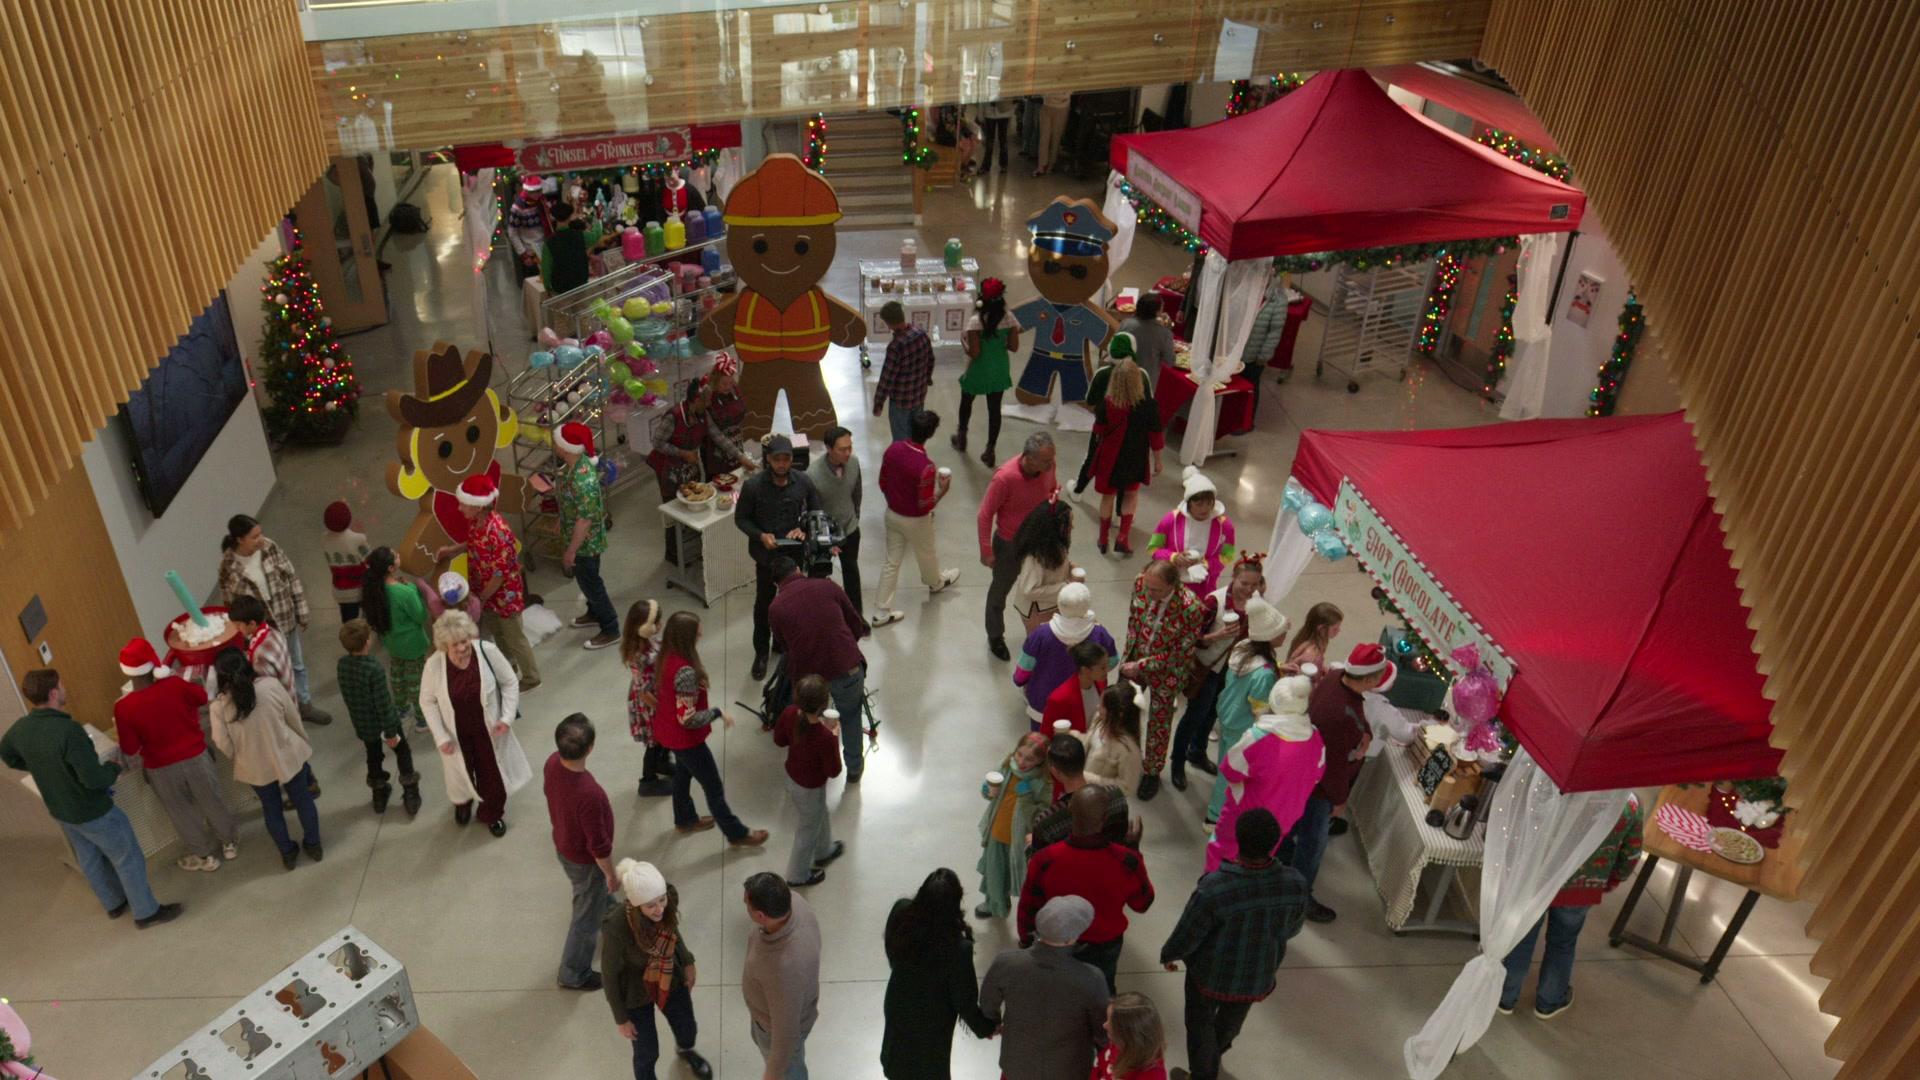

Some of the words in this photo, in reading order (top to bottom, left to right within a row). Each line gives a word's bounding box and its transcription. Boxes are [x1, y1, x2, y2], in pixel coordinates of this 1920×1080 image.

[548, 145, 590, 165] TINSEL
[597, 140, 654, 160] TRINKETS
[1367, 527, 1393, 568] HOT
[1393, 559, 1456, 642] CHOCOLATE
